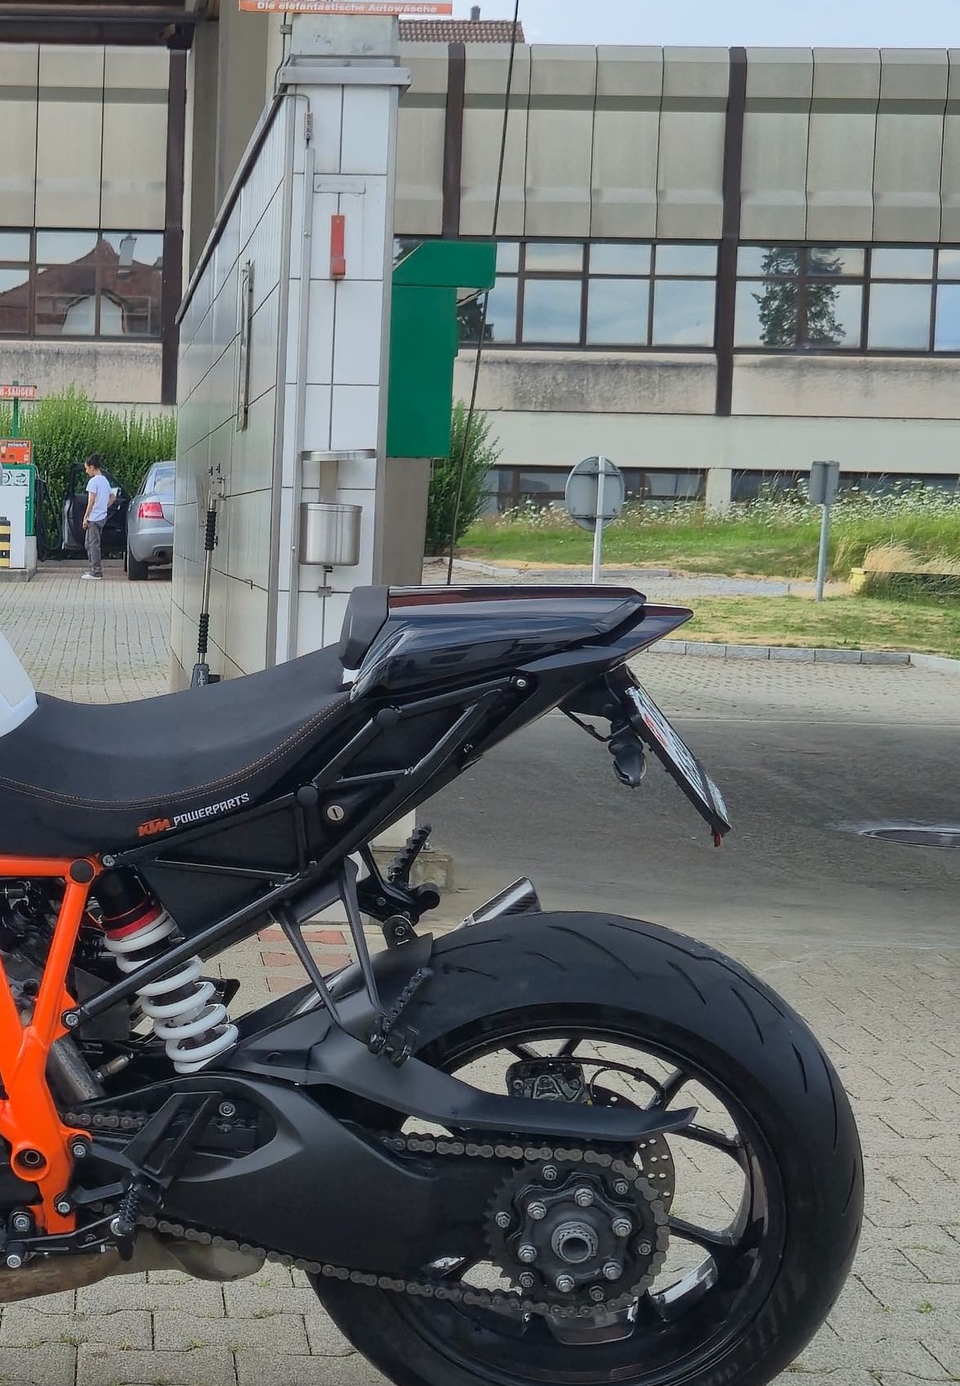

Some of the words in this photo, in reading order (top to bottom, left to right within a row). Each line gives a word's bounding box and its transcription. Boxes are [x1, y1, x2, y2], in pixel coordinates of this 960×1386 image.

[257, 1, 275, 10] Die
[279, 1, 368, 12] elefantastische
[368, 2, 438, 14] Autowäsche
